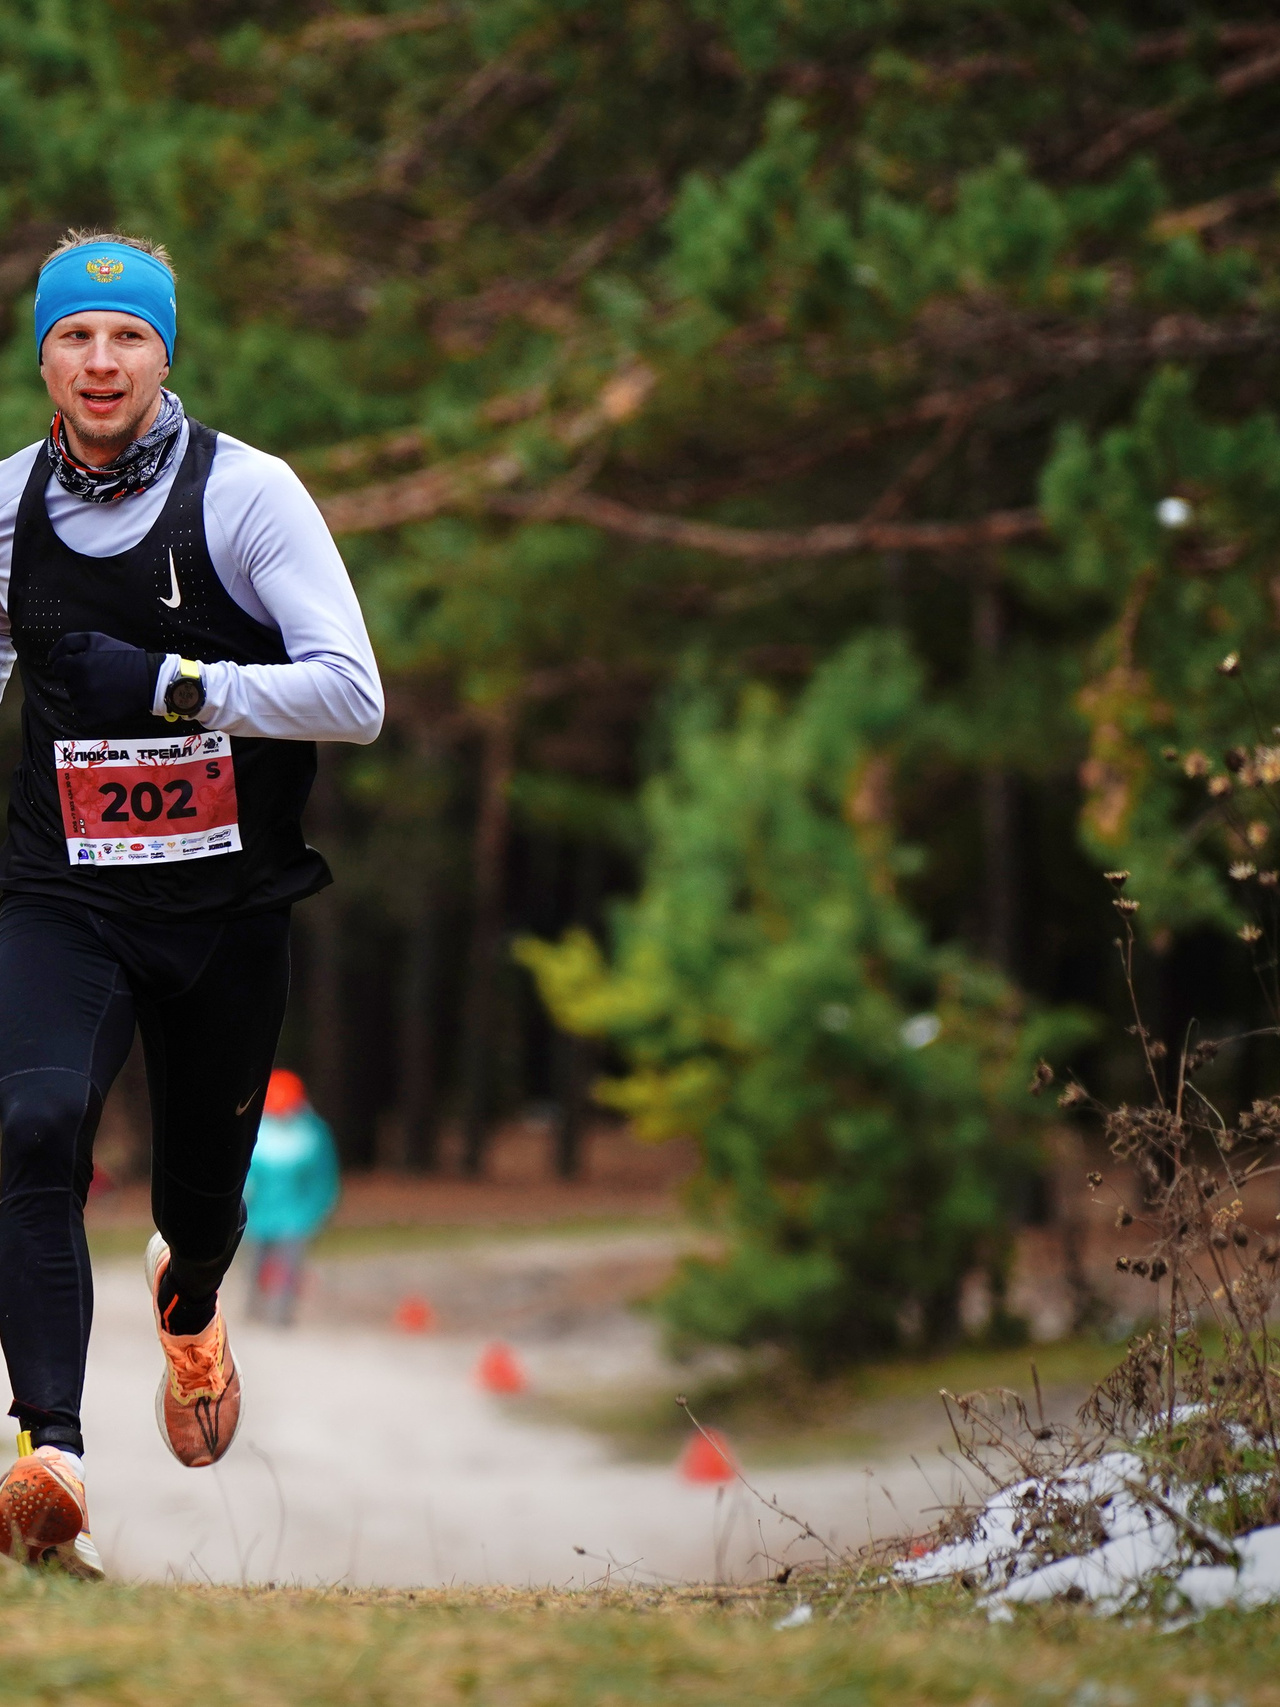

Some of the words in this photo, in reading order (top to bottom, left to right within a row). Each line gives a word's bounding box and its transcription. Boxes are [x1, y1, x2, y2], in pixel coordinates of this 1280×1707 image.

[63, 749, 130, 762] КЛЮКВА
[137, 744, 193, 760] ТРЕЙЛ
[205, 761, 221, 779] S
[98, 779, 197, 822] 202
